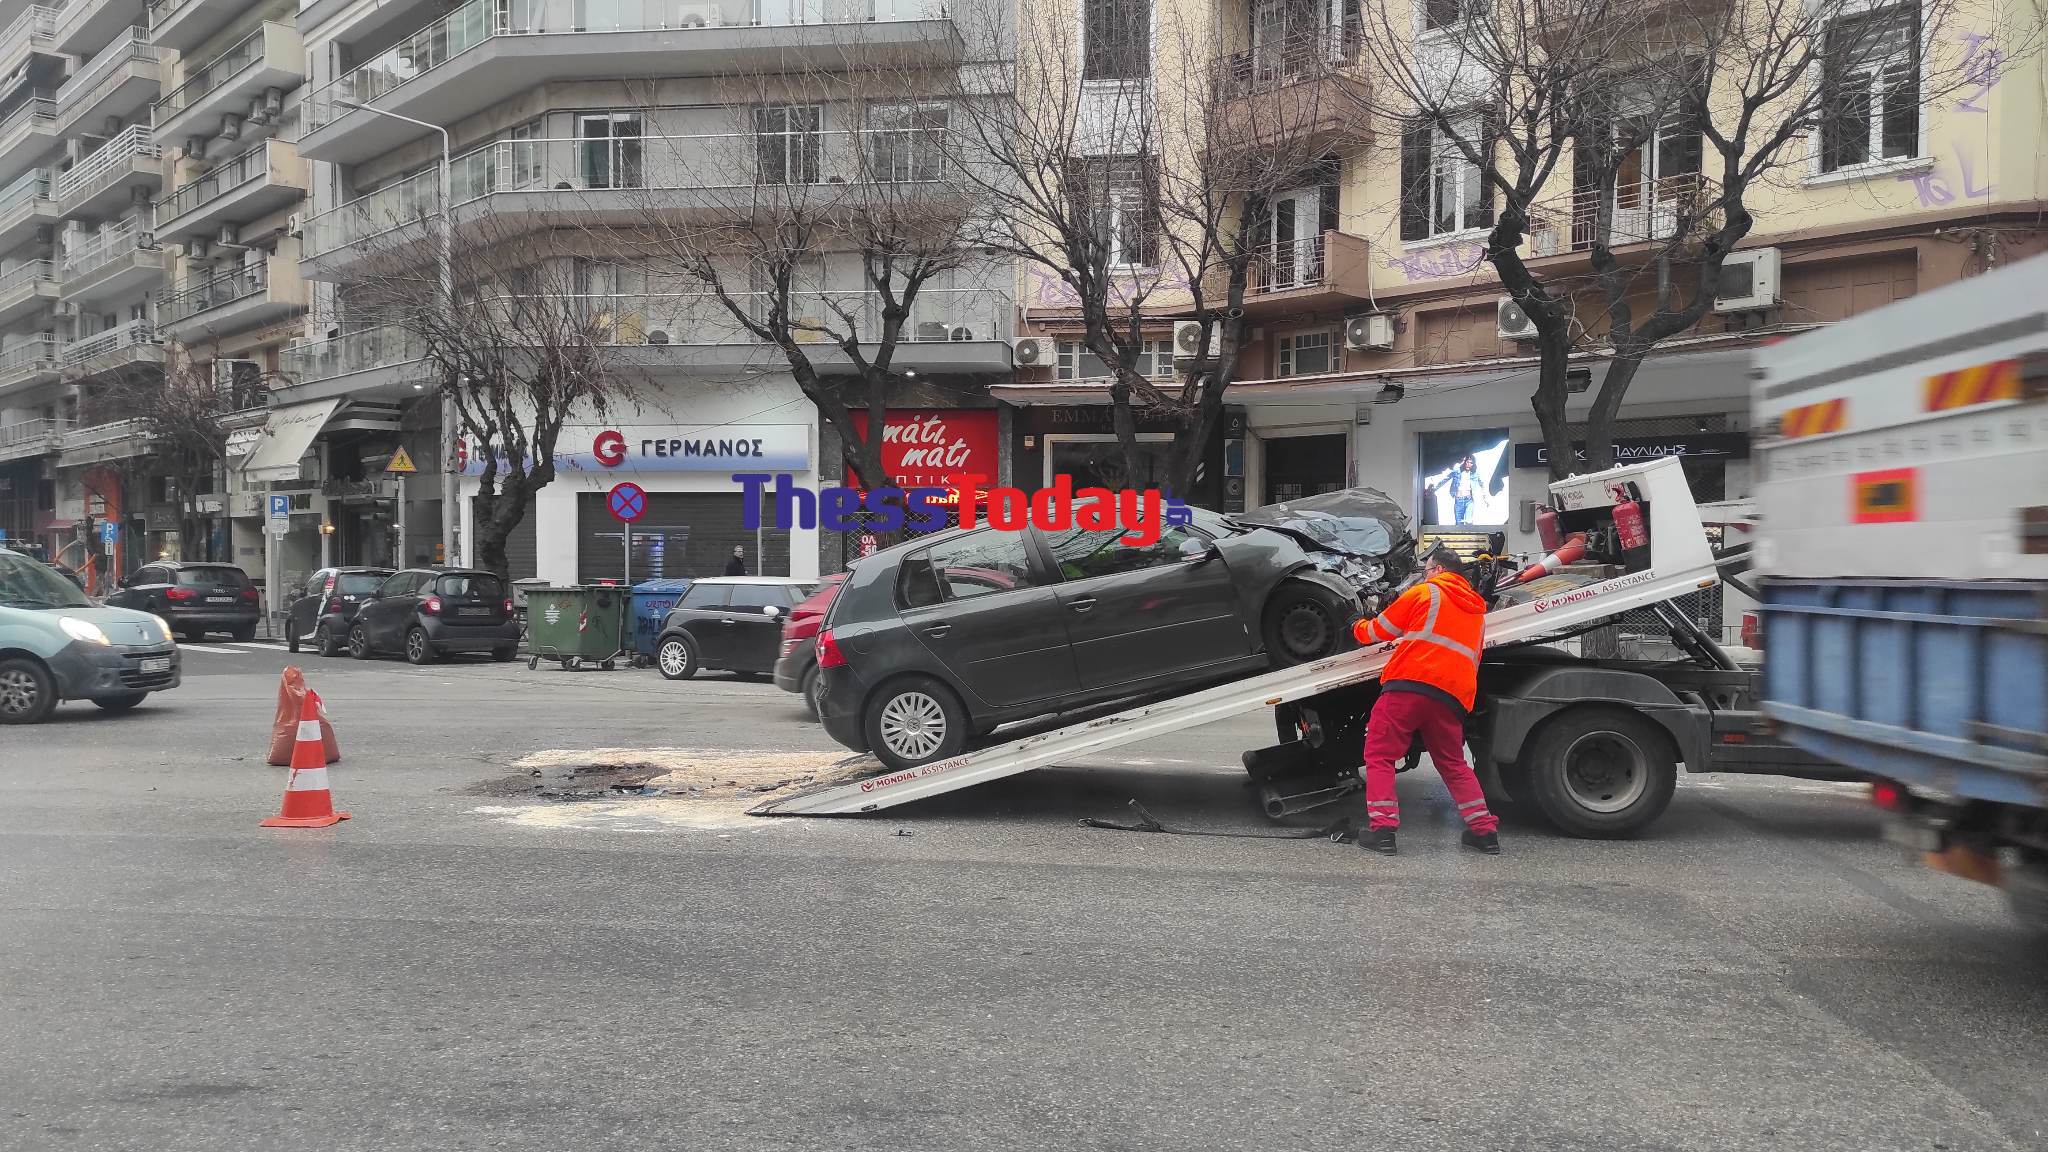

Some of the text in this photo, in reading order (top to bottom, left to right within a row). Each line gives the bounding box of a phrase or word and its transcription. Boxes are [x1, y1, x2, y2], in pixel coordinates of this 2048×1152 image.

[641, 439, 763, 457] ΓΕΡΜΑΝΟΣ
[274, 498, 284, 511] P
[1551, 571, 1657, 607] MONDIAL ASSISTANCE
[876, 758, 969, 788] MONDIAL ASSISTANCE
